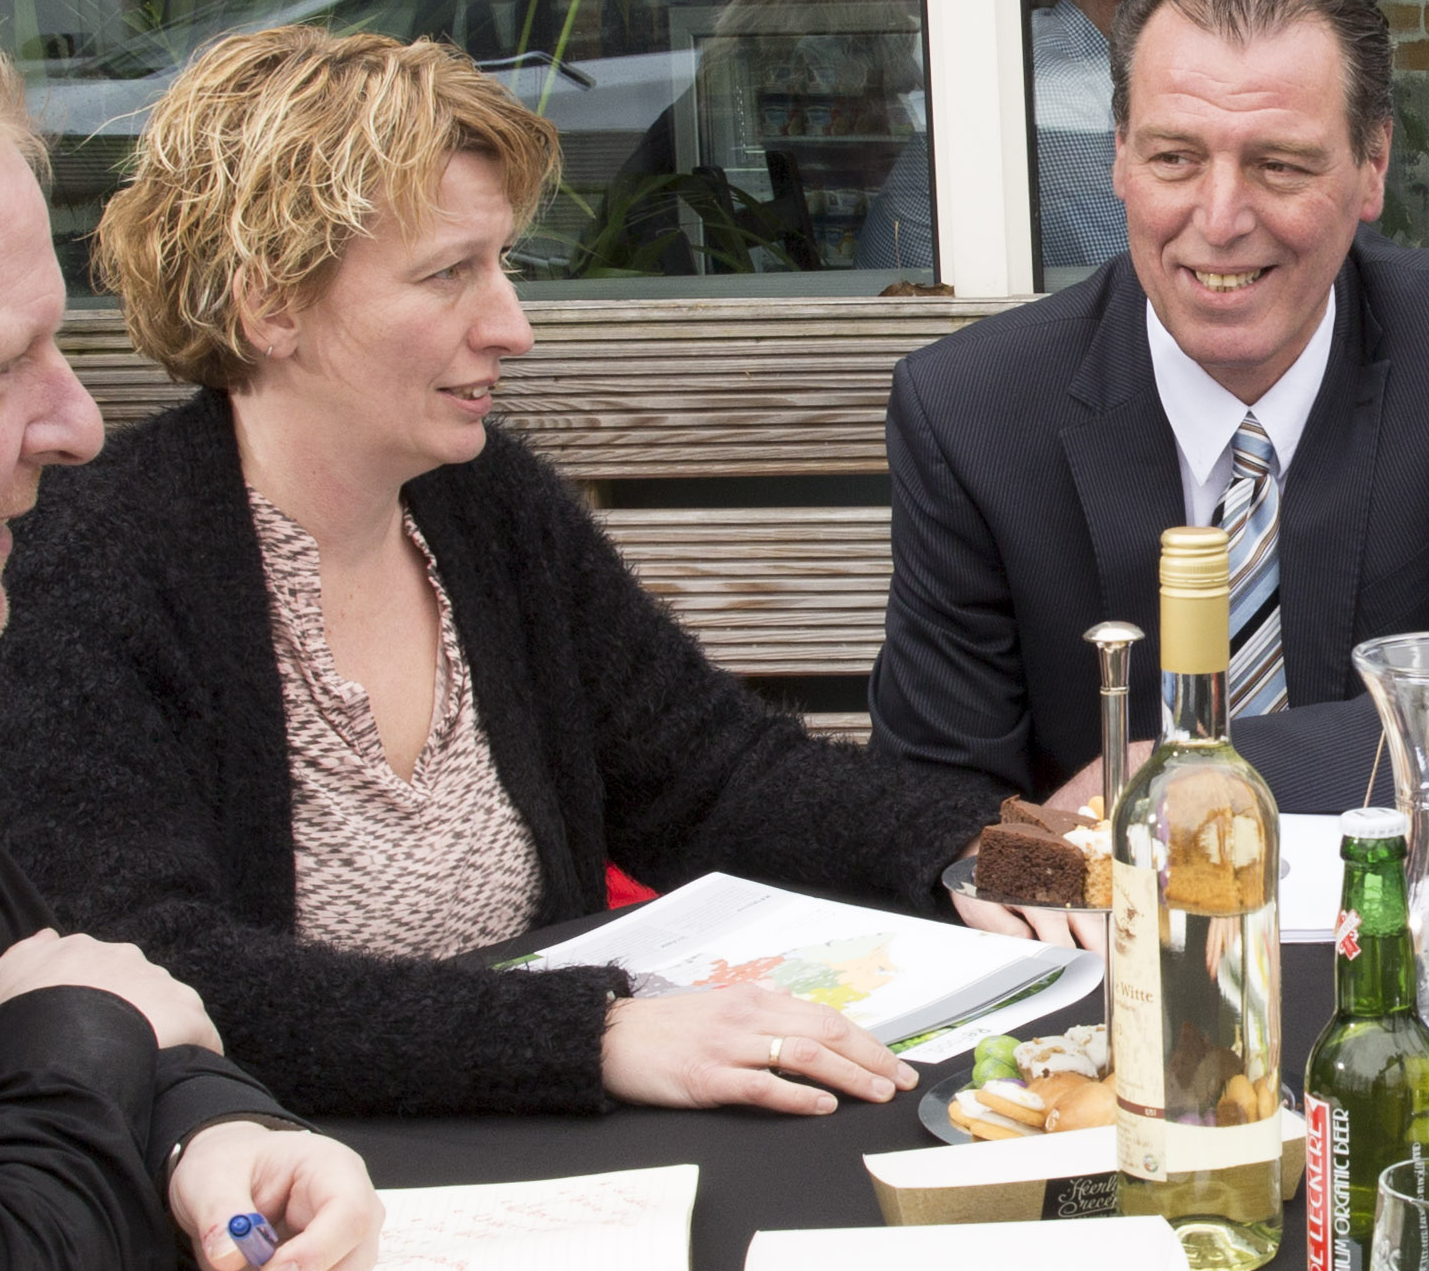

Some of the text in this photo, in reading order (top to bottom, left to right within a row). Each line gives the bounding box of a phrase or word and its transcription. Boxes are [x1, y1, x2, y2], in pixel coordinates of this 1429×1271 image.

[1332, 1107, 1350, 1156] BEER
[1308, 1118, 1325, 1243] LECKERE
[1333, 1157, 1351, 1236] ORGANIC
